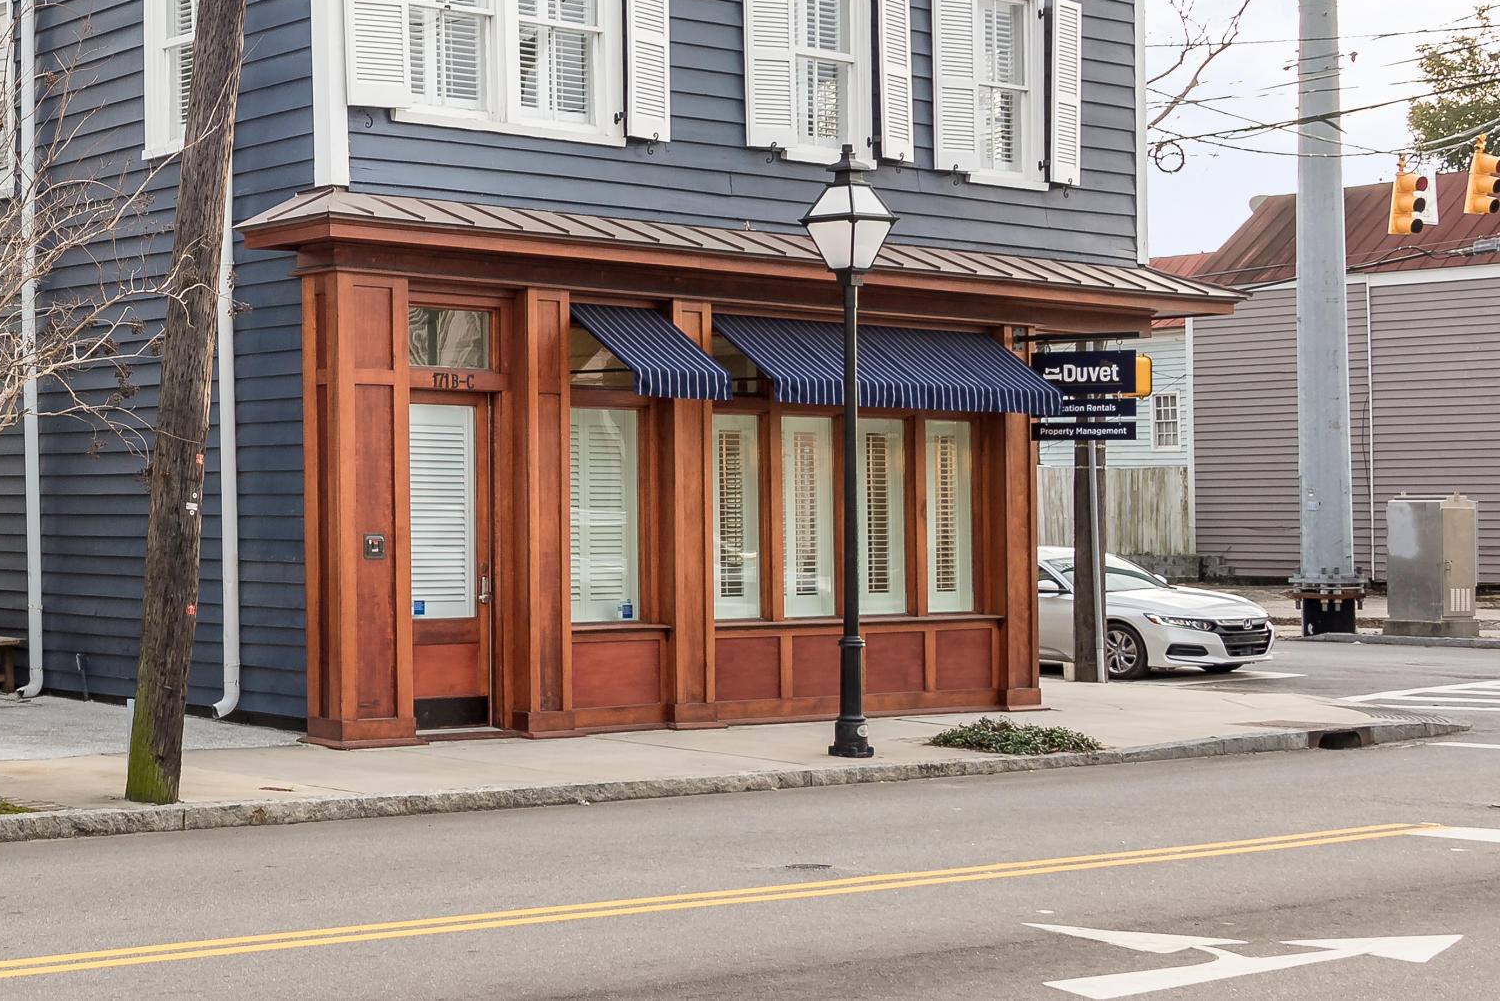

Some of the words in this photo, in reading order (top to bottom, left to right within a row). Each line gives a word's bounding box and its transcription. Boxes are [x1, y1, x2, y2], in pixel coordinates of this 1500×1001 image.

[1063, 364, 1120, 383] Duvet
[1062, 404, 1085, 412] ation
[1086, 403, 1116, 412] Rentals
[1040, 427, 1074, 436] Property
[1075, 427, 1127, 436] Management
